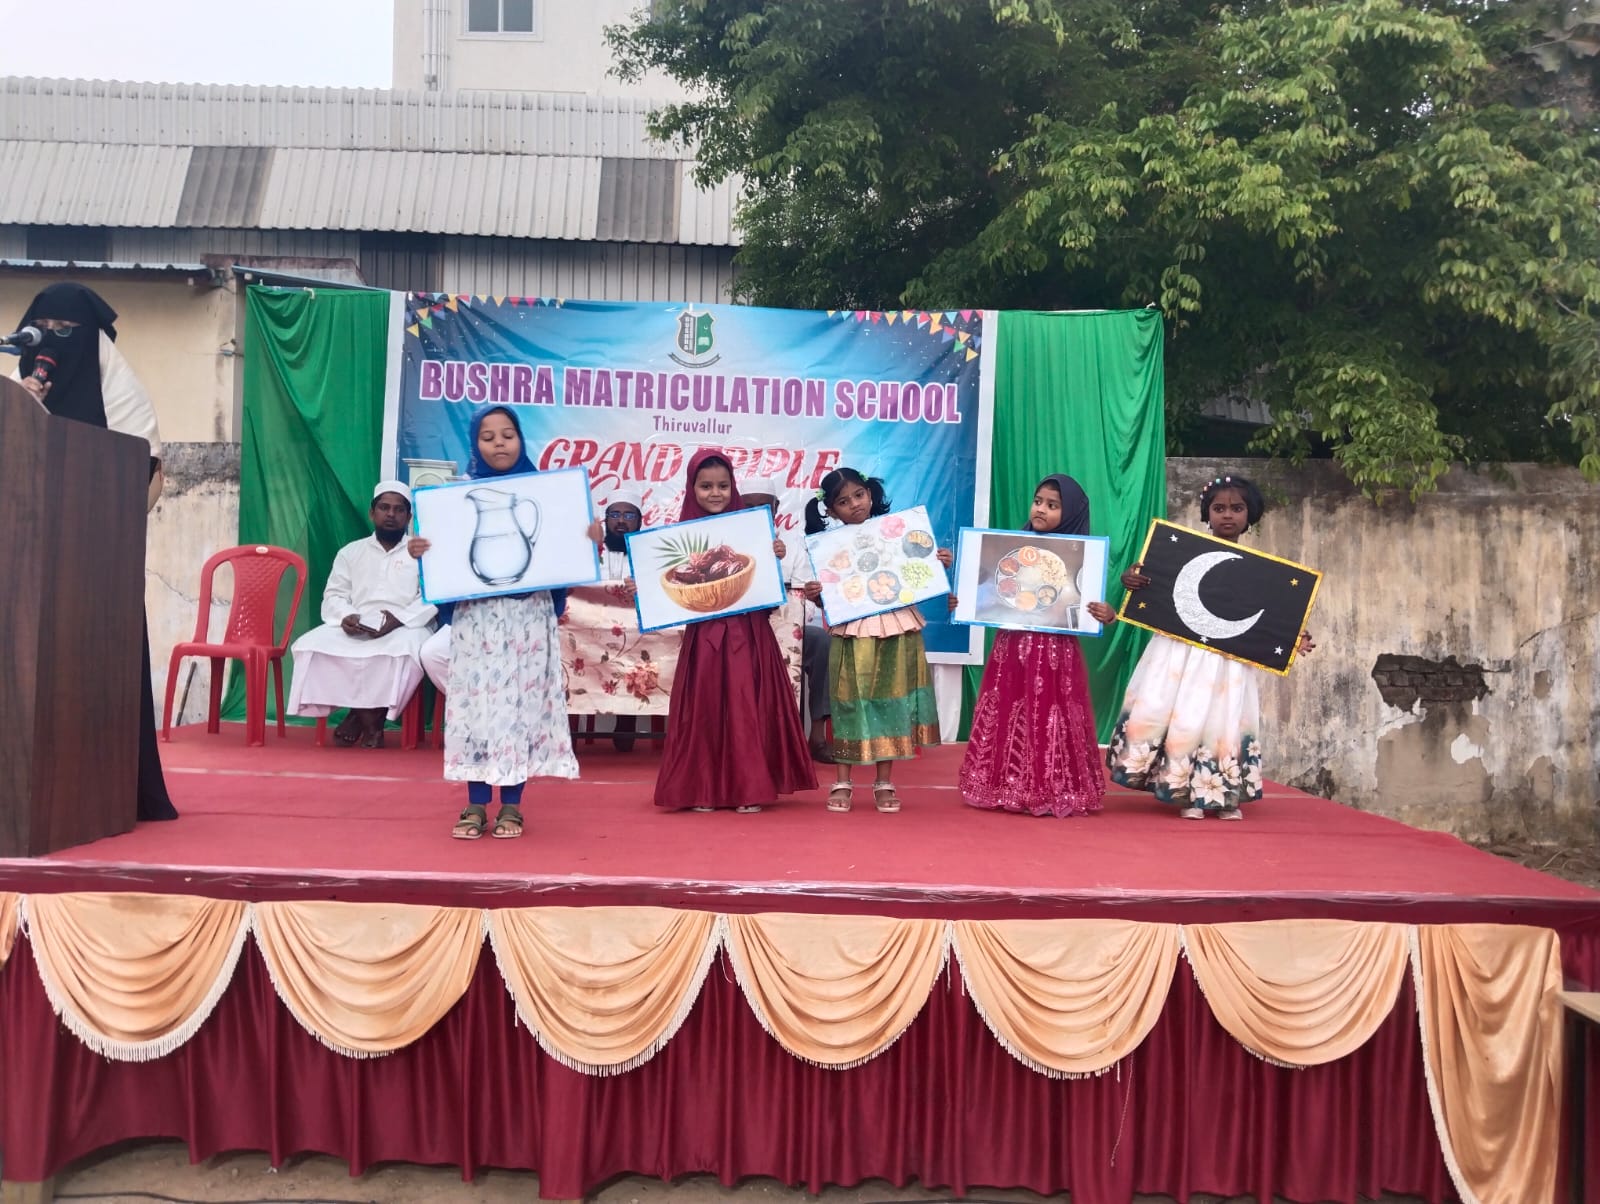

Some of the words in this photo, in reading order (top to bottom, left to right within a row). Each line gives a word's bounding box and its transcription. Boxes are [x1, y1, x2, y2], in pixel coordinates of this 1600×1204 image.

[420, 361, 555, 405] BUSHRA
[564, 368, 825, 418] MATRICULATION
[834, 380, 961, 422] SCHOOL
[652, 415, 733, 434] Thiruvallur
[539, 438, 683, 483] GRAND
[697, 444, 840, 490] RIPLE
